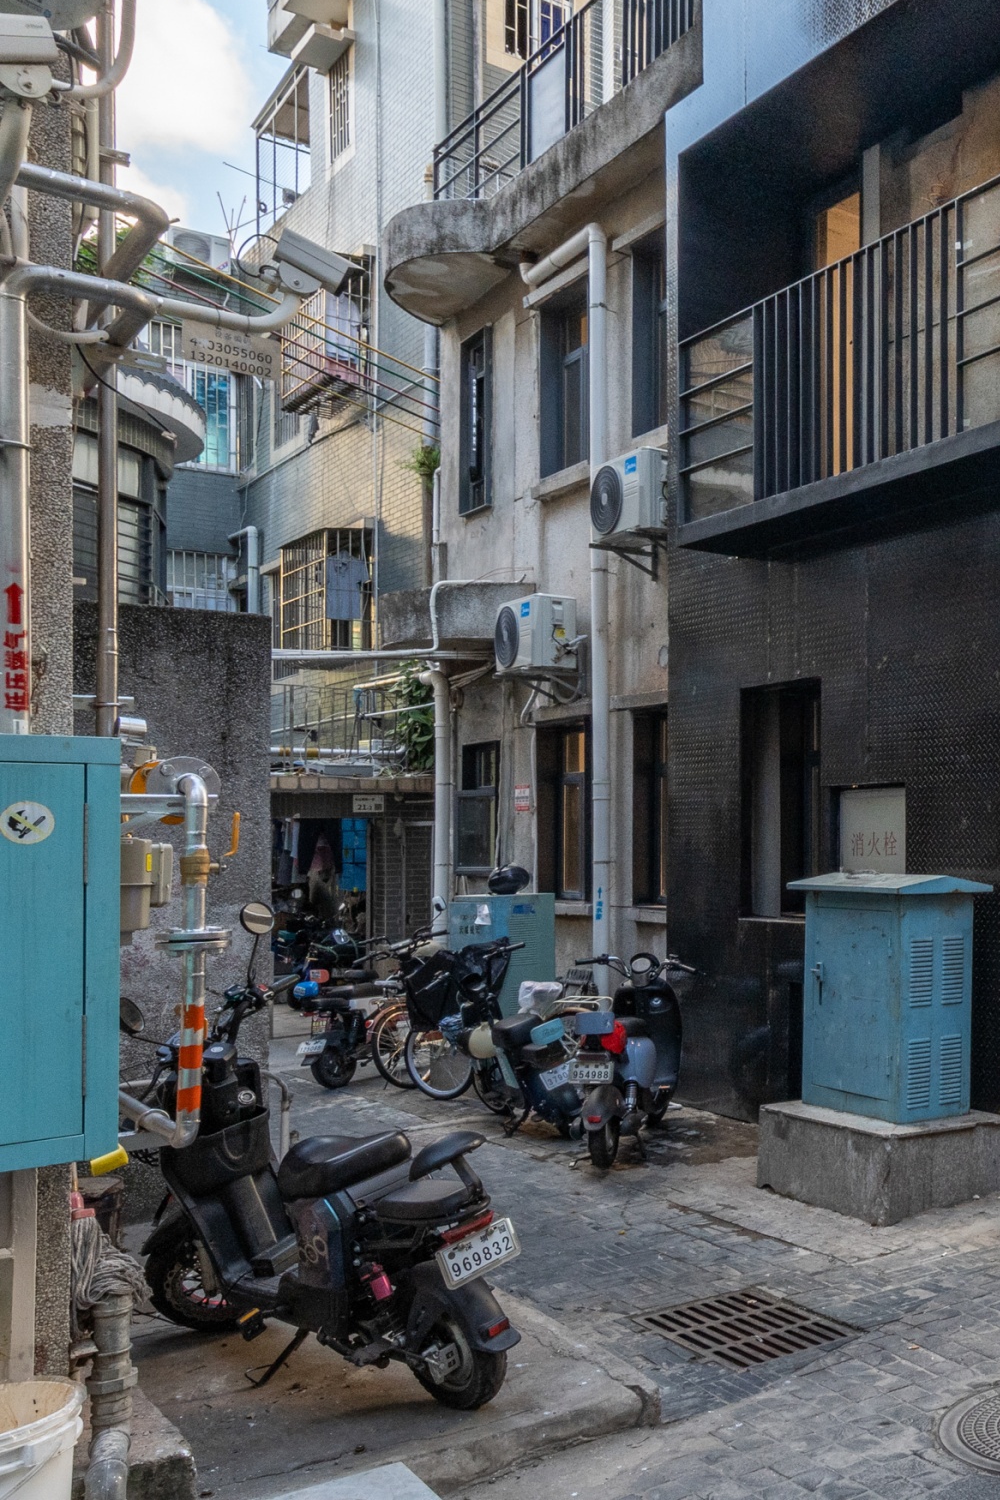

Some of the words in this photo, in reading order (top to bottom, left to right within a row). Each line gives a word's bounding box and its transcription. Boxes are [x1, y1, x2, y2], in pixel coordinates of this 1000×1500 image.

[189, 337, 273, 365] 403055060
[190, 350, 272, 378] 1320140002
[851, 831, 897, 857] 消火栓
[572, 1070, 609, 1079] 954988
[451, 1236, 513, 1277] 969832
